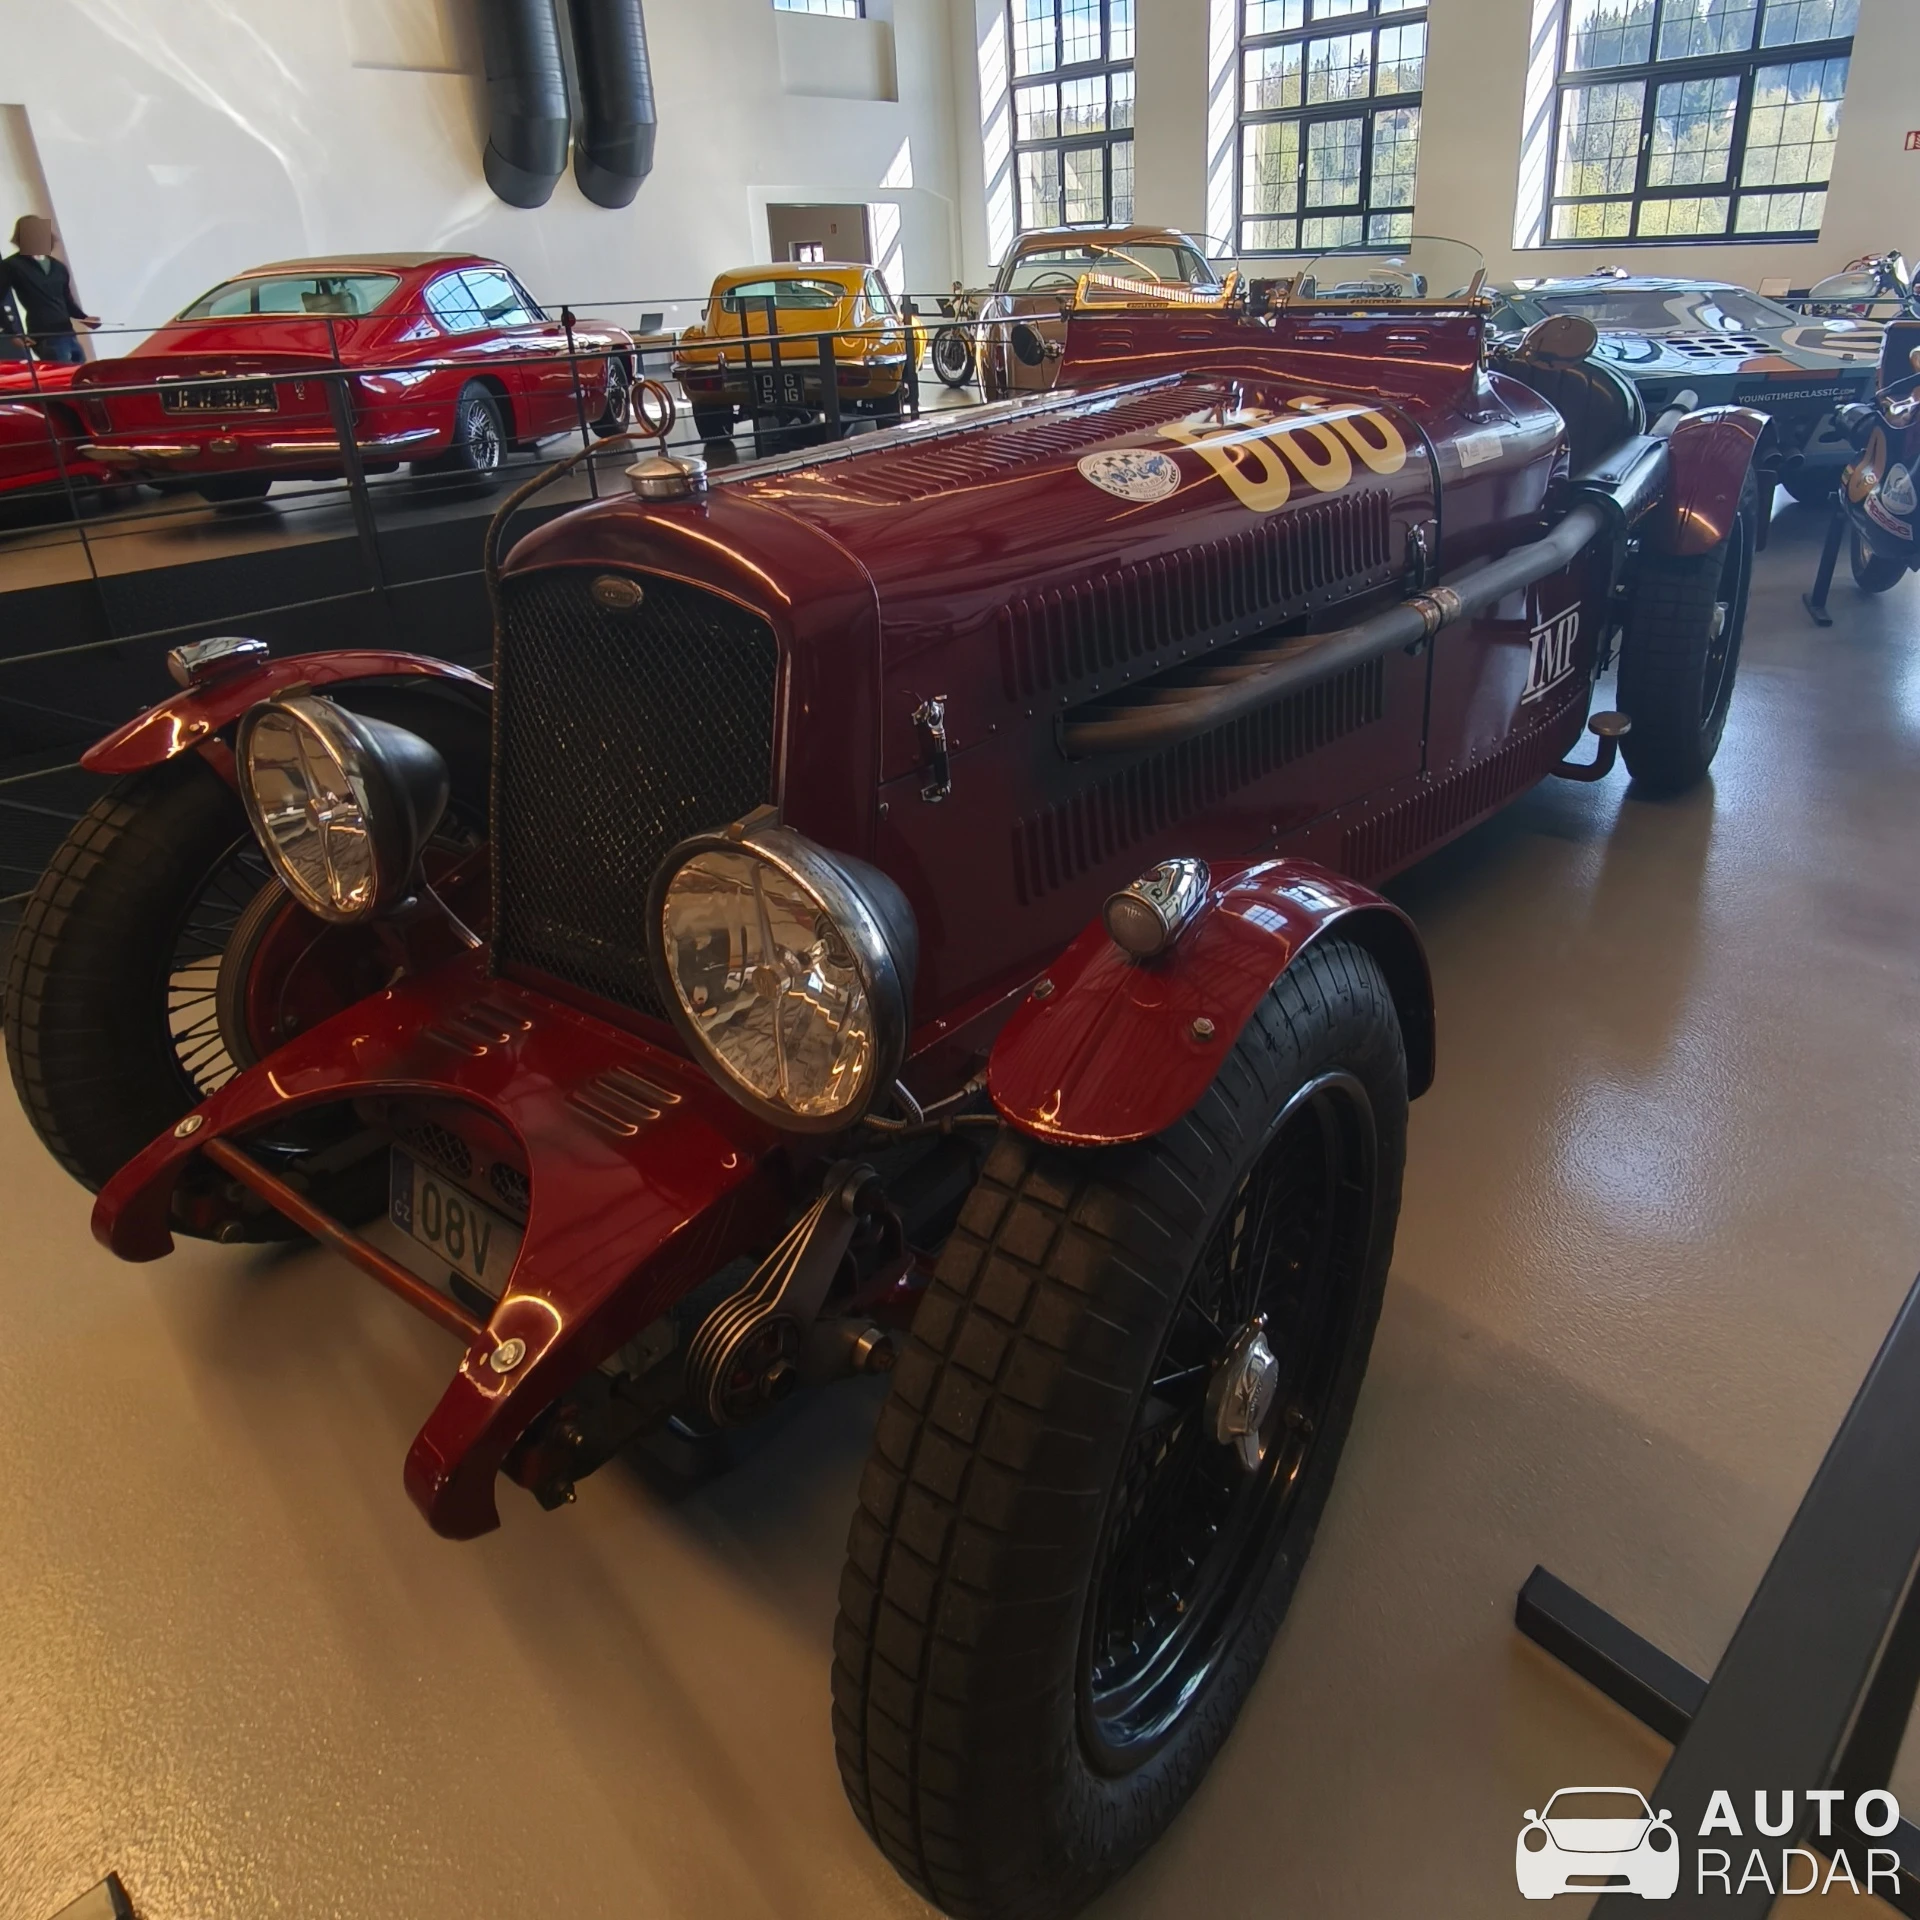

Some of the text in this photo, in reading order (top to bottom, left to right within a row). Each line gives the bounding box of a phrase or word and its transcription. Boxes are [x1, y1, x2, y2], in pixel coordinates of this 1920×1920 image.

[763, 374, 795, 388] DG
[763, 388, 799, 403] 51G
[1522, 611, 1580, 696] IMP
[394, 1200, 411, 1222] CZ
[421, 1181, 492, 1277] 08V
